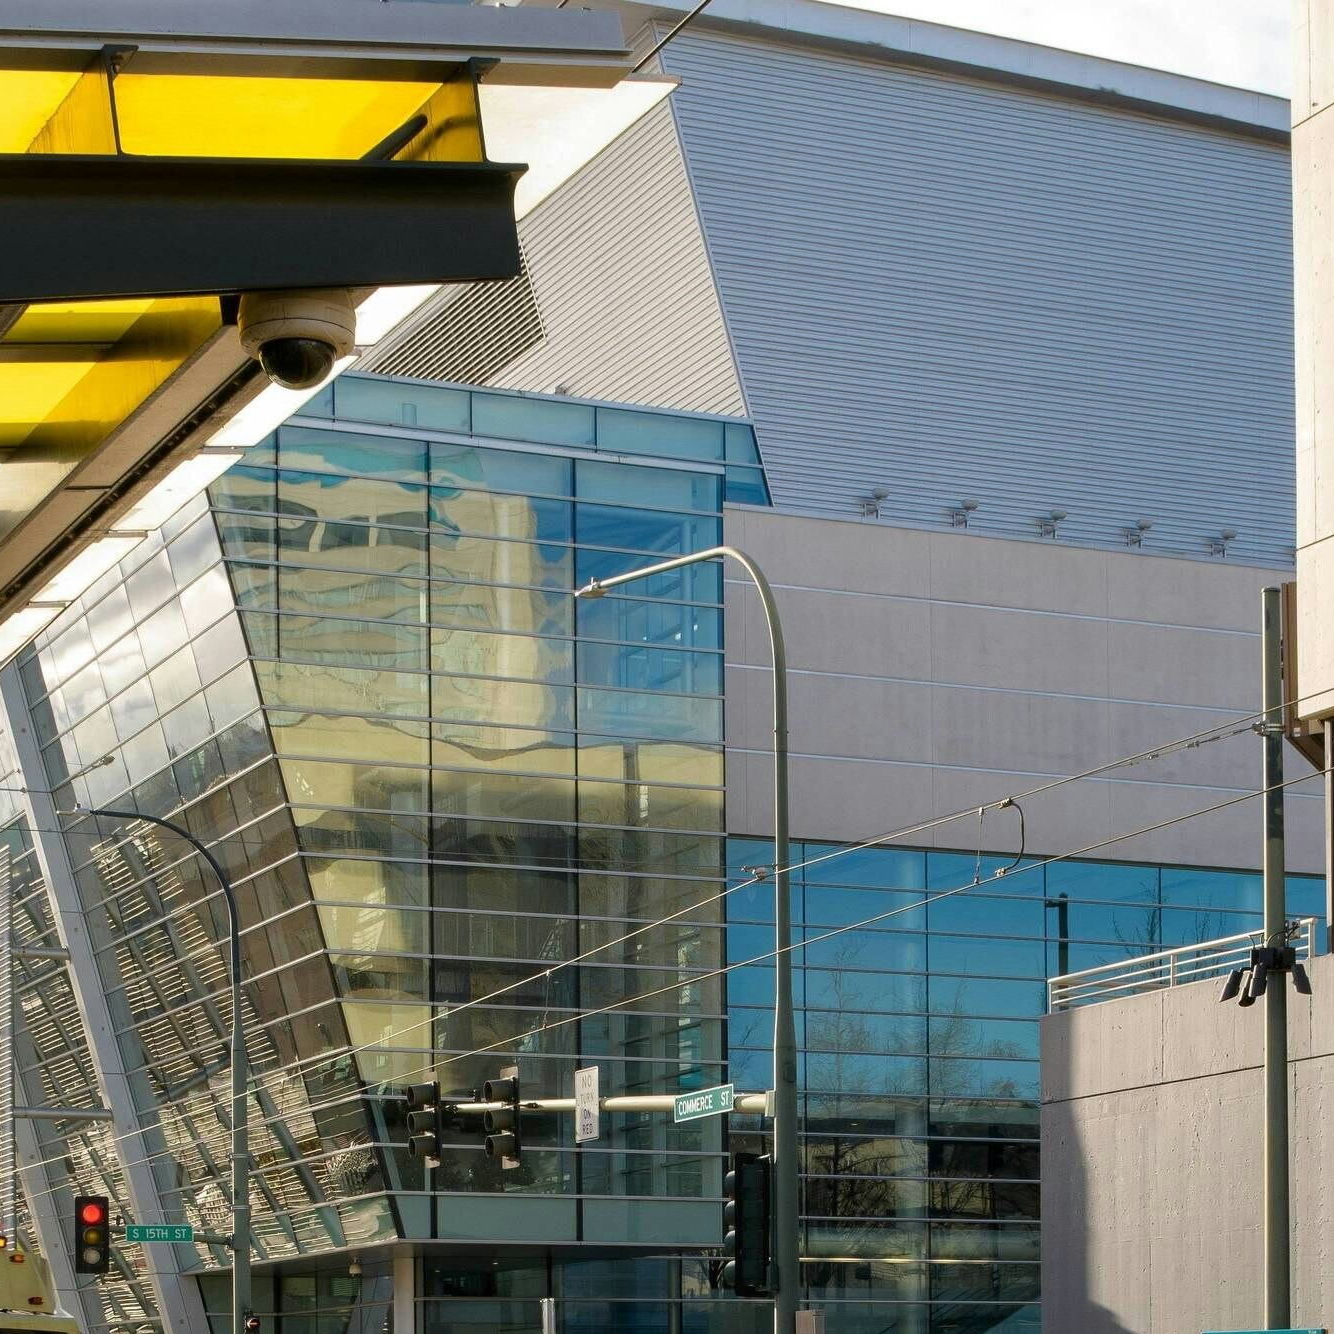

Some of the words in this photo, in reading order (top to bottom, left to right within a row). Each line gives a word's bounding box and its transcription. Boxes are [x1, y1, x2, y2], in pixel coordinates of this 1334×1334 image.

[581, 1074, 592, 1088] NO
[678, 1094, 713, 1116] COMMERCE
[720, 1090, 730, 1106] ST
[132, 1228, 139, 1239] S
[146, 1228, 168, 1239] 15TH
[174, 1228, 187, 1239] ST
